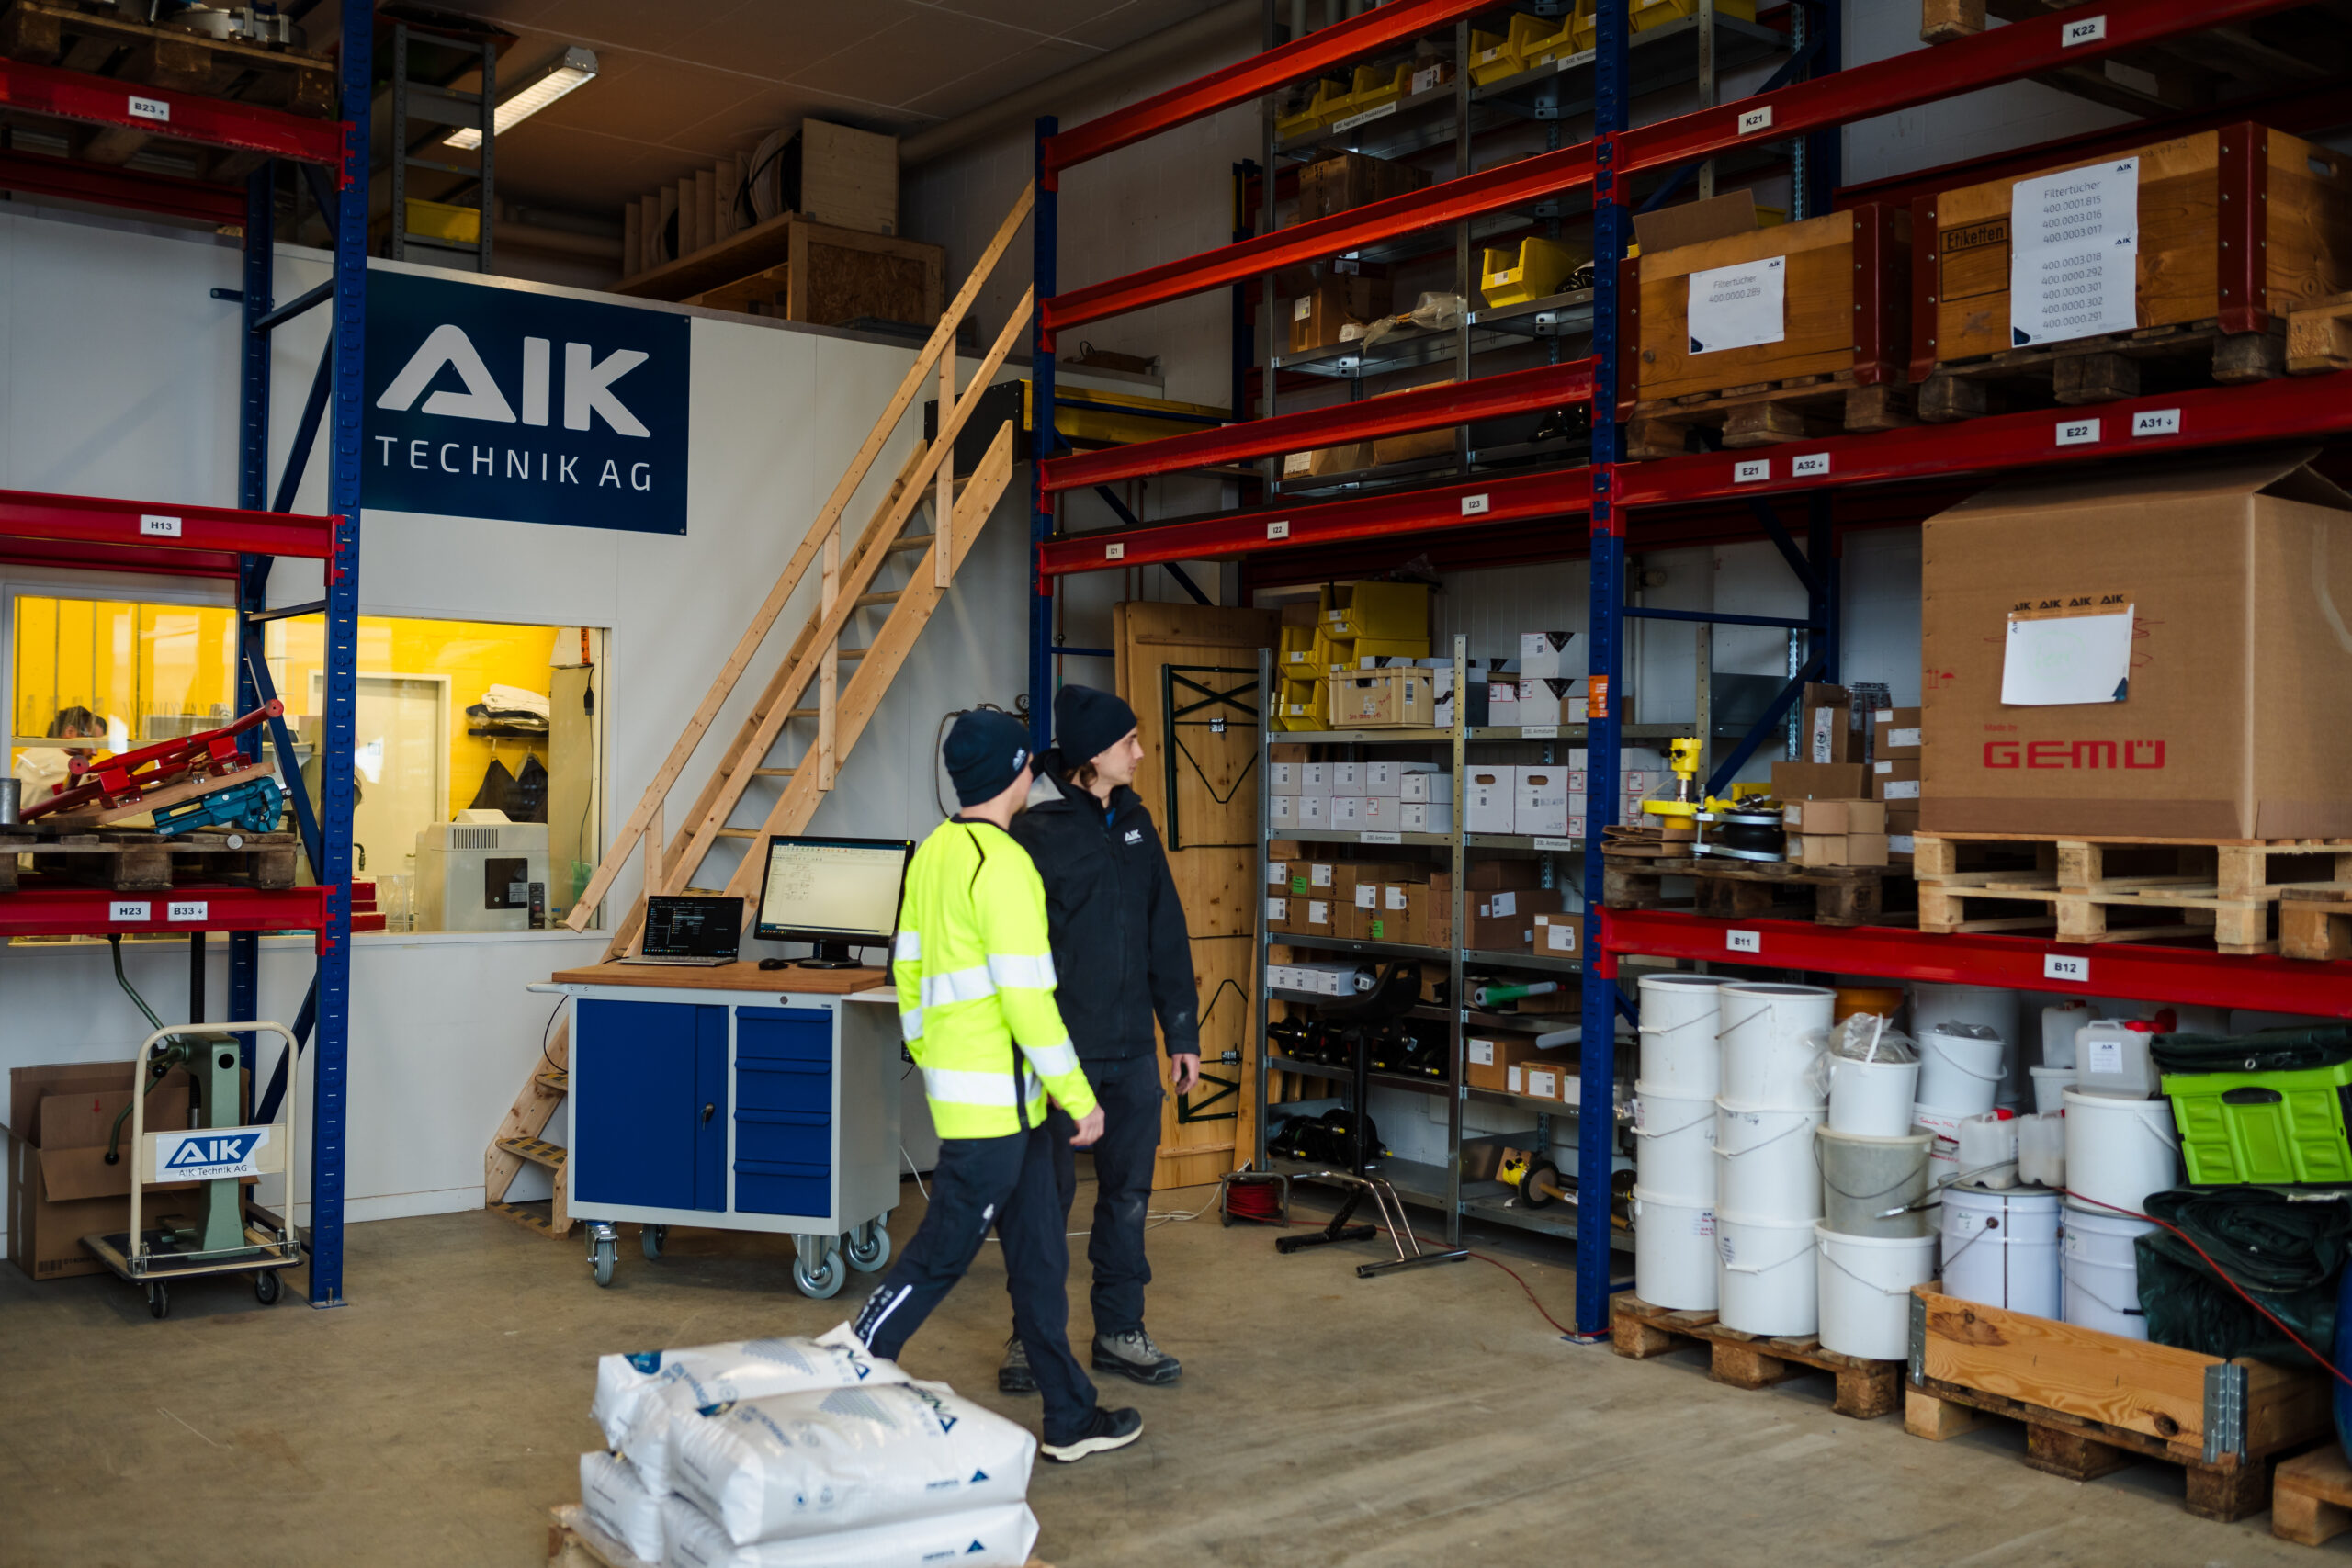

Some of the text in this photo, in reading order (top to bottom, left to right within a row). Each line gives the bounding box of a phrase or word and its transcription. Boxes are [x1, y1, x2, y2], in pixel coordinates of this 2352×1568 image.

[2072, 24, 2096, 38] K22
[134, 102, 156, 114] B23
[1746, 114, 1763, 127] K21
[2117, 164, 2132, 172] AIK
[2044, 181, 2102, 199] Filtertücher
[2043, 195, 2102, 214] 400.0001.815
[2042, 210, 2103, 229] 400.0003.016
[1948, 227, 2004, 250] Etiketten
[2043, 224, 2103, 243] 400.0003.017
[2115, 237, 2132, 245] AIK
[376, 324, 650, 437] AIK
[2139, 417, 2163, 428] A31
[2066, 426, 2088, 437] E22
[375, 435, 650, 491] TECHNIK AG
[1797, 460, 1816, 470] A32
[1742, 466, 1759, 476] E21
[151, 521, 172, 531] H13
[2039, 599, 2061, 610] AIK
[2068, 597, 2091, 607] AIK
[2100, 594, 2124, 604] AIK
[1984, 740, 2165, 769] GEMÜ
[1125, 829, 1141, 842] AIK
[119, 908, 141, 916] H23
[174, 908, 194, 916] B33
[1735, 937, 1750, 946] B11
[2054, 962, 2076, 973] B12
[173, 1139, 242, 1165] AIK
[179, 1164, 248, 1177] AIK Technik AG
